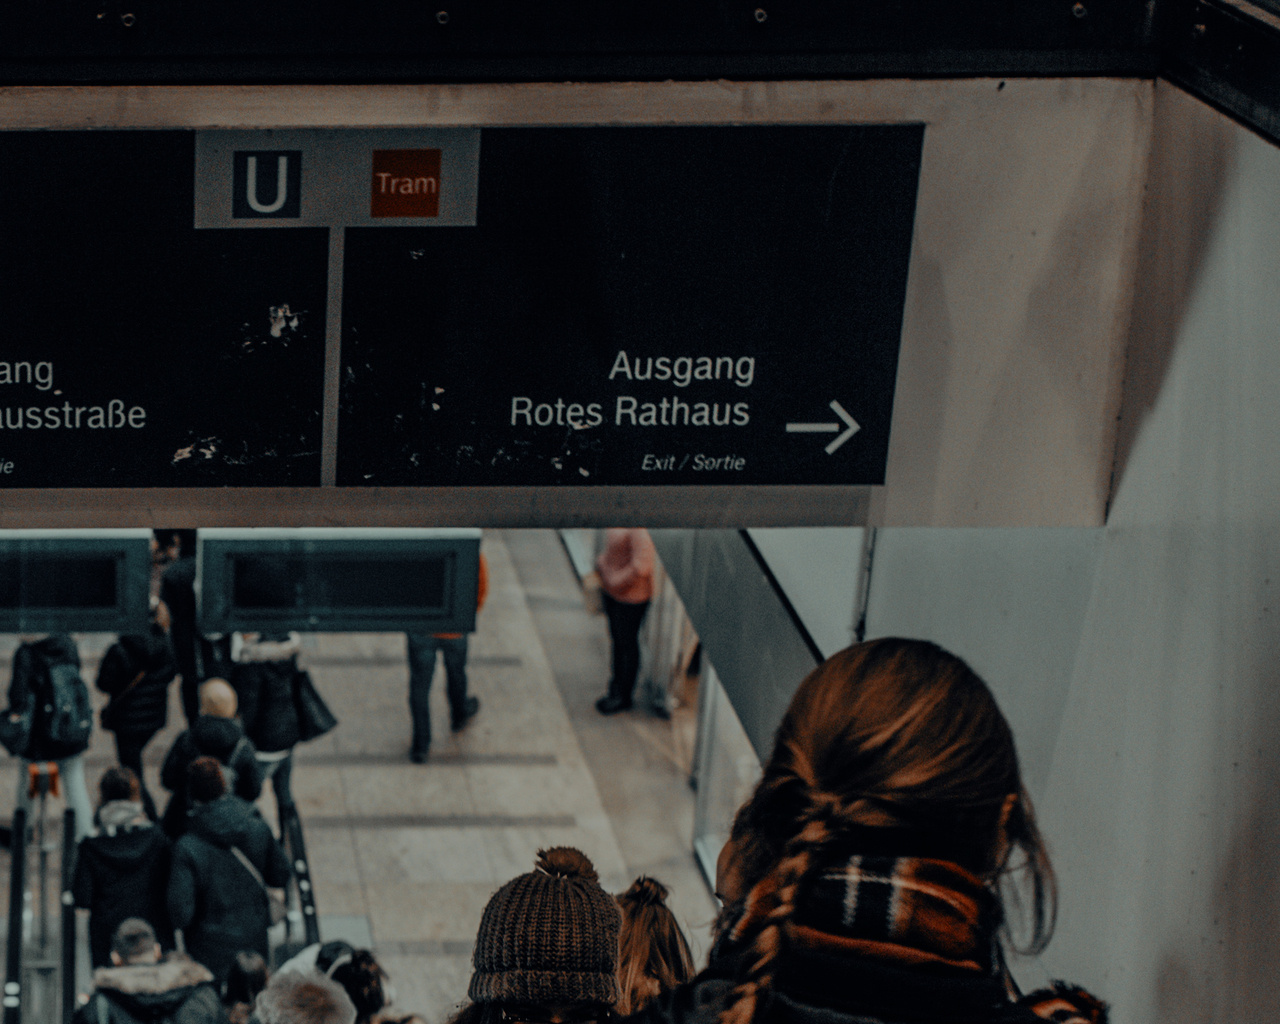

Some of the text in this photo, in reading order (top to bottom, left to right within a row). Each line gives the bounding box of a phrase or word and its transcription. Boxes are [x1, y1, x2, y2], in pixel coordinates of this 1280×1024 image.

[246, 156, 288, 213] U
[376, 172, 437, 196] Tram
[608, 350, 756, 388] Ausgang
[510, 395, 750, 427] Rotes Rathaus
[641, 453, 746, 471] Exit / Sortie
